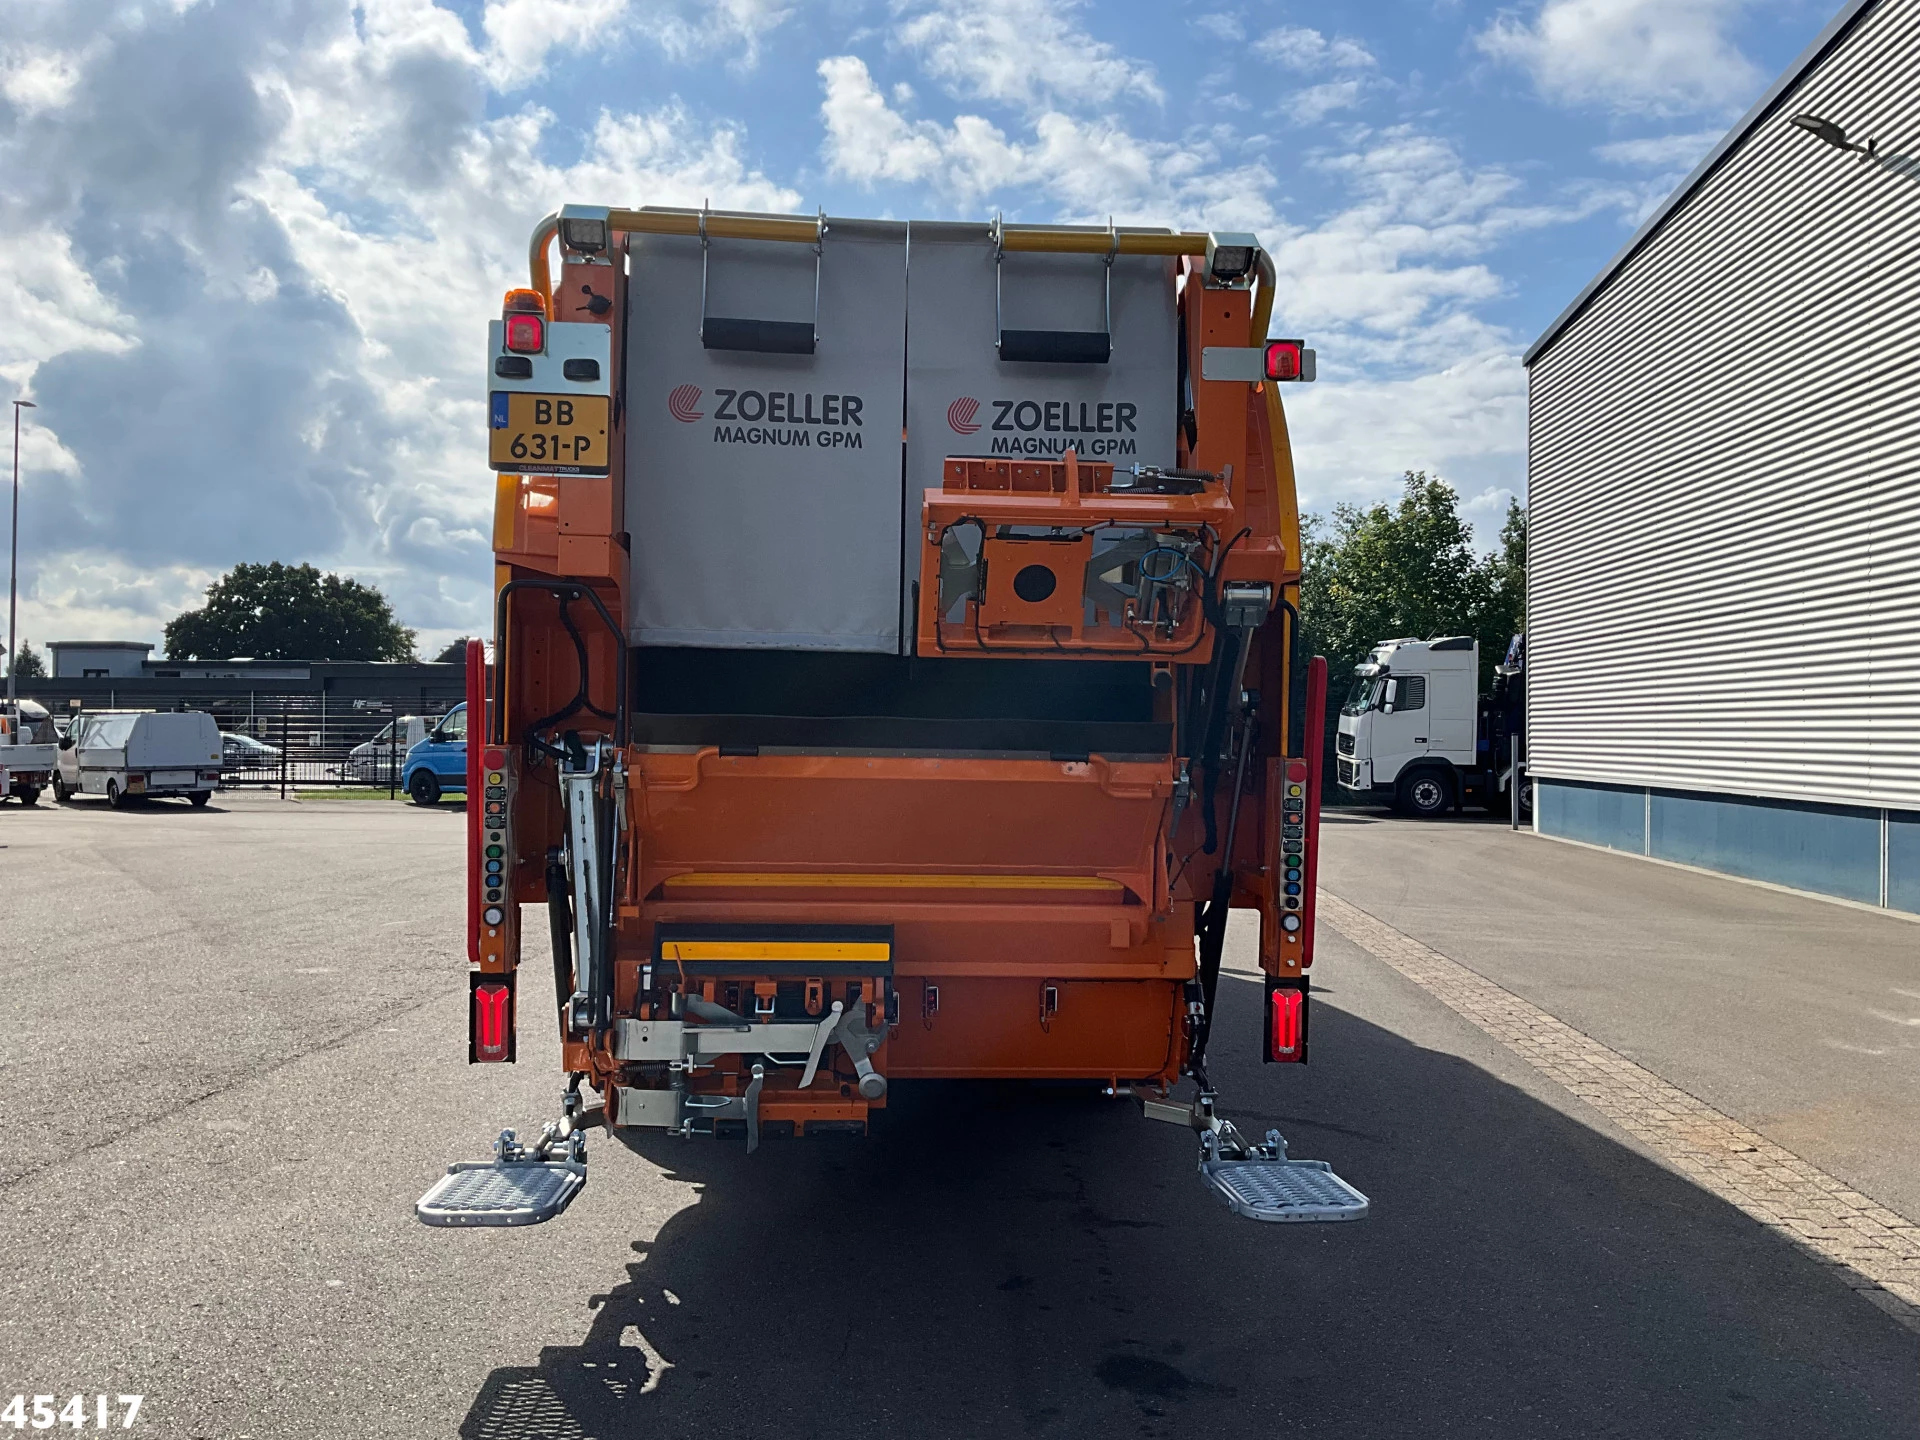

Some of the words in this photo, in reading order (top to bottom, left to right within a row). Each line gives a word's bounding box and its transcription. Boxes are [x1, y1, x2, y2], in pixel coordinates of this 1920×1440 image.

[494, 414, 507, 423] NL
[535, 399, 574, 426] BB
[713, 388, 863, 427] ZOELLER
[991, 400, 1137, 433] ZOELLER
[510, 433, 591, 461] 631-P
[713, 425, 810, 447] MAGNUM
[816, 430, 863, 449] GPM
[991, 436, 1085, 455] MAGNUM
[1091, 438, 1137, 455] GPM
